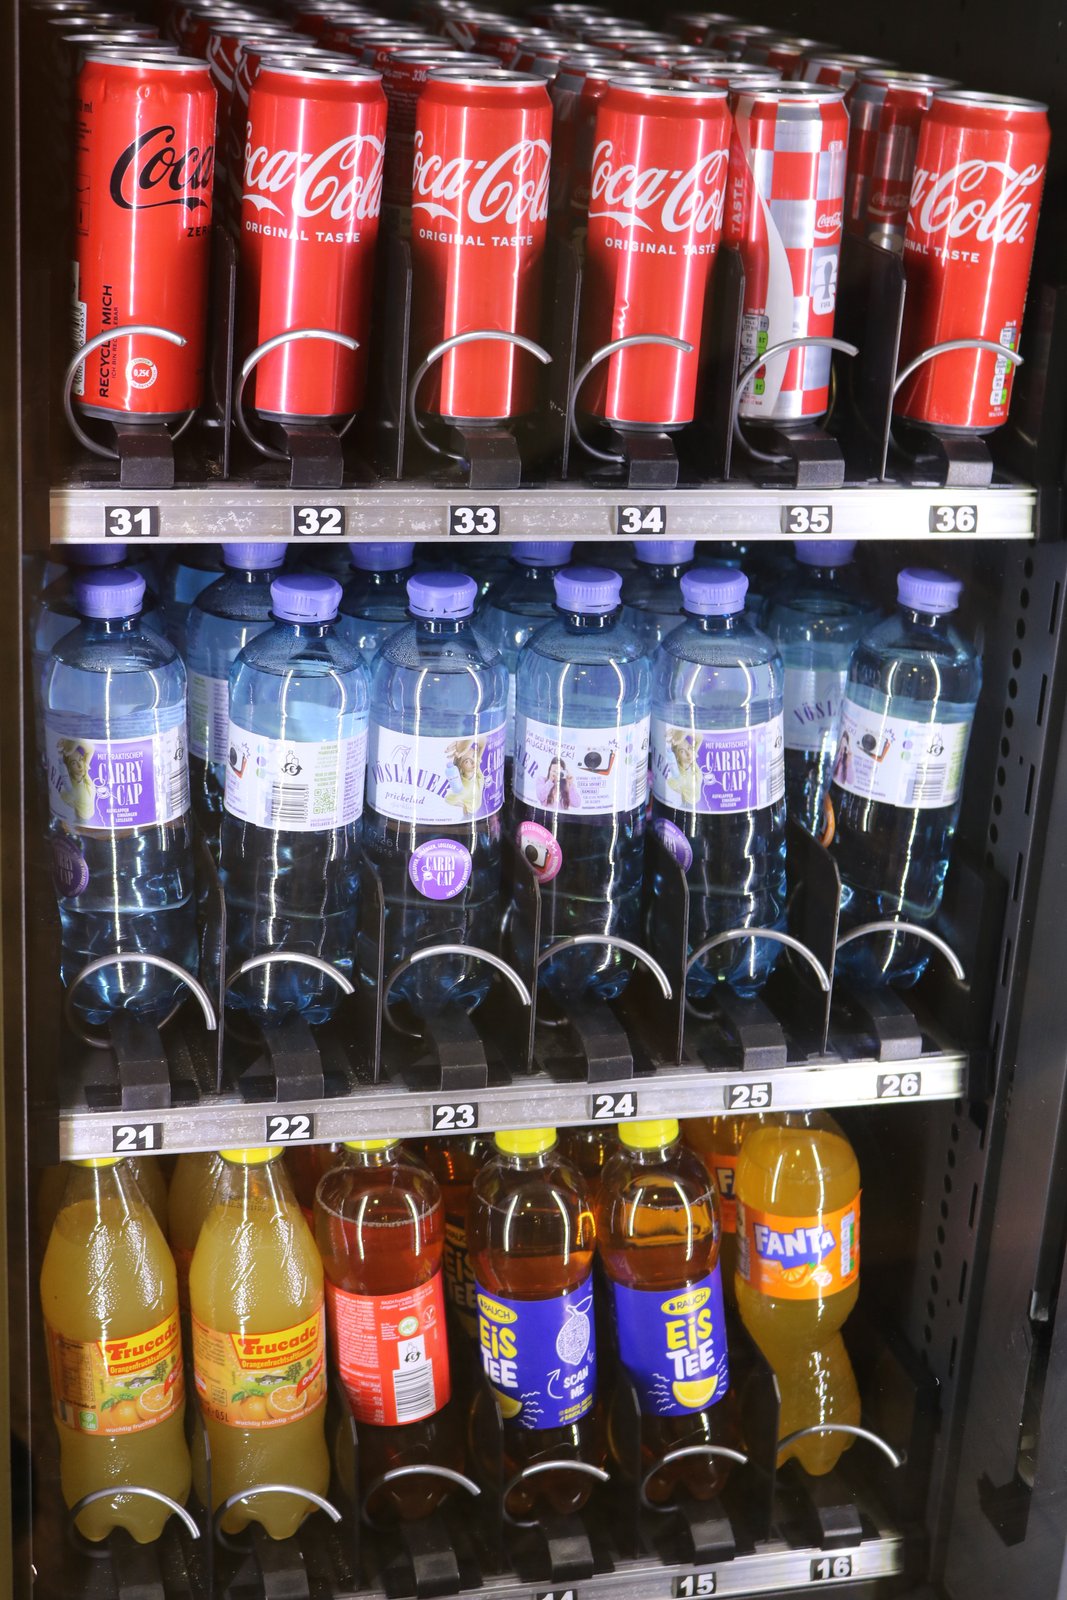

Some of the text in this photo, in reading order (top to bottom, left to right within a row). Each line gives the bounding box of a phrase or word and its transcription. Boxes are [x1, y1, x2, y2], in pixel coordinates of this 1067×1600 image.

[731, 178, 744, 234] TASTE
[246, 220, 360, 243] ORIGINAL TASTE
[419, 229, 533, 247] ORIGINAL TASTE
[605, 236, 676, 255] ORIGINAL
[683, 242, 716, 255] TASTE
[934, 246, 980, 263] TASTE
[99, 285, 112, 398] RECYCL MICH
[110, 508, 151, 535] 31
[298, 508, 342, 534] 32
[454, 507, 496, 534] 33
[621, 507, 663, 533] 34
[790, 506, 829, 532] 35
[936, 506, 976, 531] 36
[706, 748, 747, 771] CARRY
[99, 760, 143, 784] CARRY
[722, 770, 746, 792] CAP
[117, 783, 142, 805] CAP
[426, 855, 456, 871] CARRY
[437, 870, 455, 886] CAP
[731, 1083, 769, 1108] 25
[882, 1074, 918, 1097] 26
[435, 1104, 476, 1129] 23
[595, 1093, 635, 1118] 24
[116, 1125, 155, 1150] 21
[269, 1115, 311, 1140] 22
[754, 1224, 835, 1257] FANTA
[676, 1292, 706, 1309] RAUCH
[481, 1348, 518, 1388] TEE
[665, 1339, 715, 1380] TEE
[563, 1364, 588, 1388] SCAN
[570, 1382, 585, 1399] ME
[816, 1557, 850, 1580] 16
[680, 1573, 714, 1597] 15
